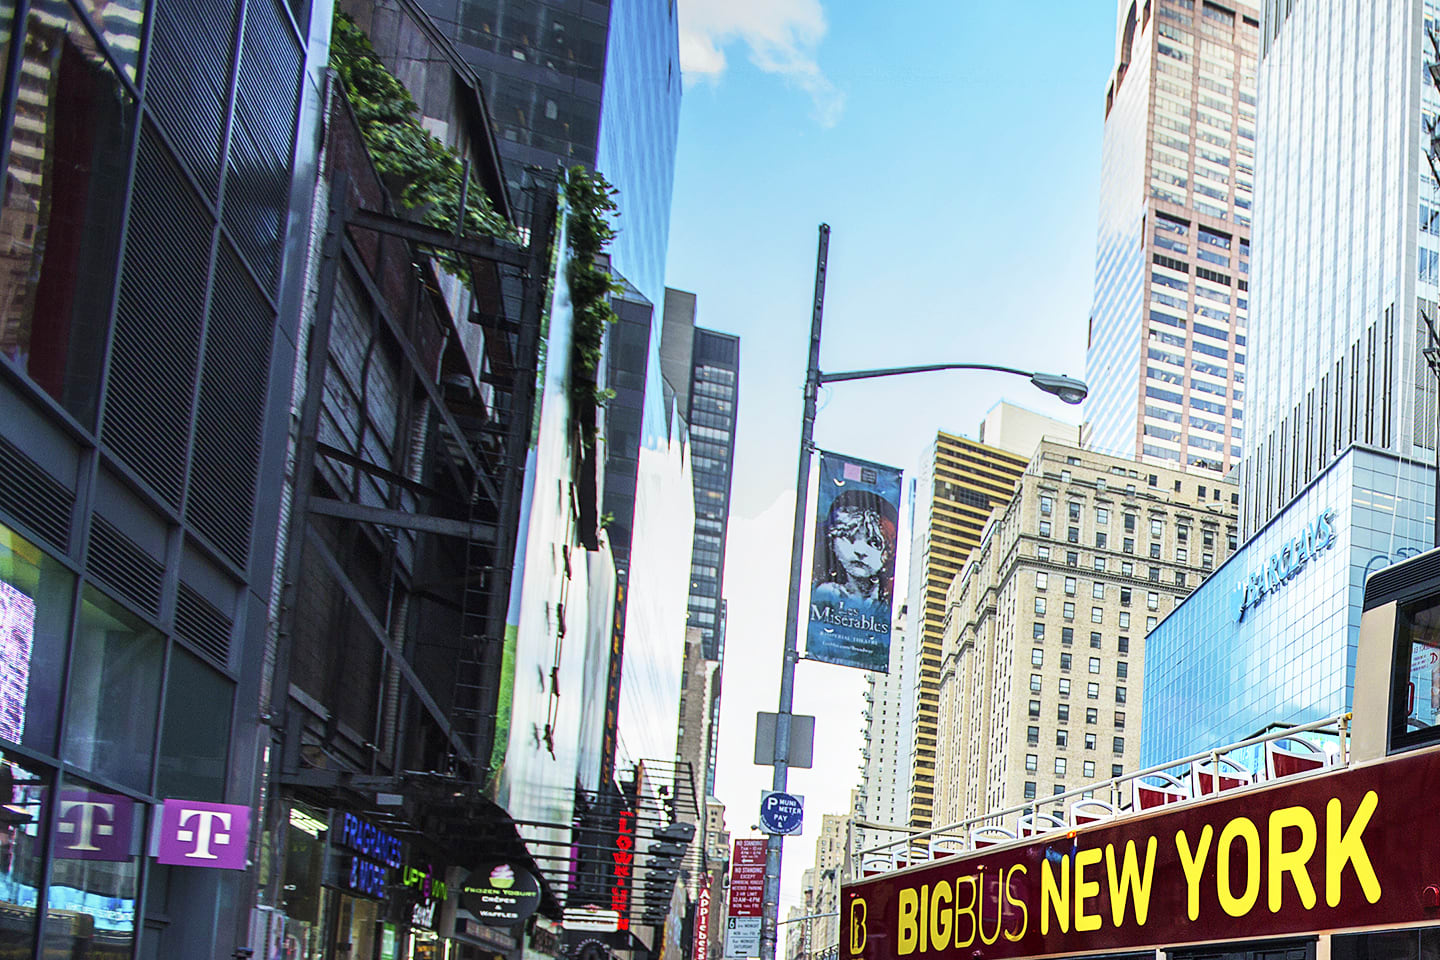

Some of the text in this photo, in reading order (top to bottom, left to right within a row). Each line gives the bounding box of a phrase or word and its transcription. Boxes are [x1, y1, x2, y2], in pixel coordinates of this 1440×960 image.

[1246, 507, 1333, 606] BARCLAYS
[838, 601, 859, 616] Les
[767, 797, 796, 810] P MUNI
[779, 805, 802, 815] METER
[774, 813, 788, 821] PAY
[178, 809, 231, 859] T
[1040, 834, 1157, 936] NEW
[1175, 790, 1382, 922] YORK
[350, 856, 359, 888] &
[729, 918, 736, 929] 6
